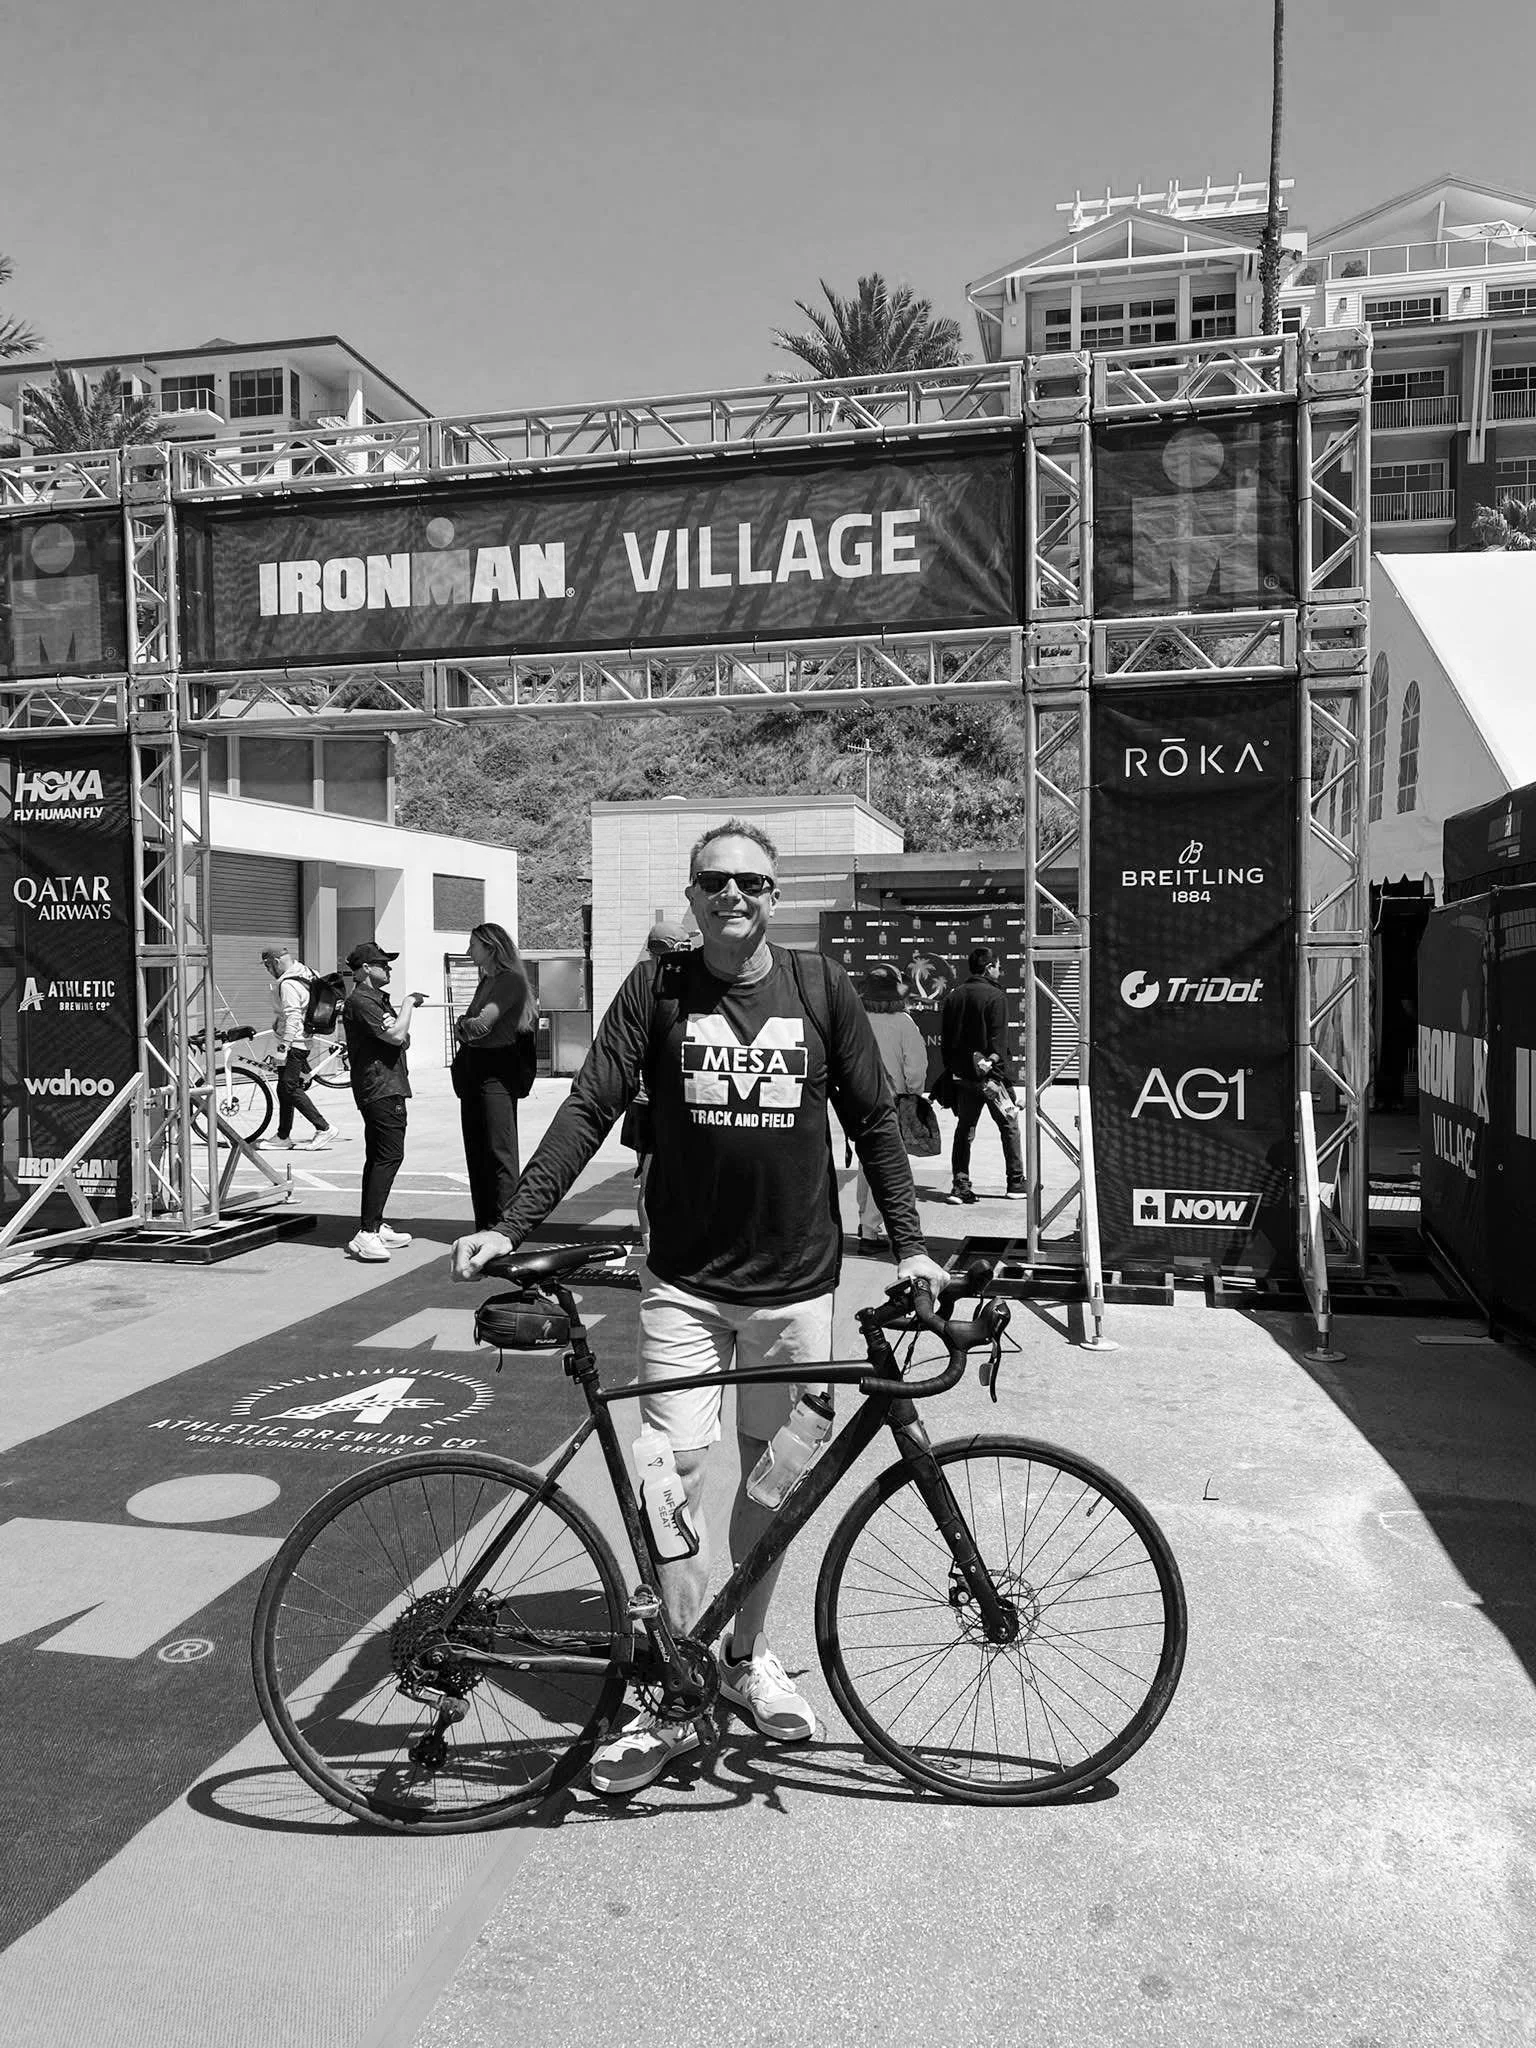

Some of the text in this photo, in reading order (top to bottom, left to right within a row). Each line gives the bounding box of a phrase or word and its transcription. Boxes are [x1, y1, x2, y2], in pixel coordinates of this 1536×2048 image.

[259, 508, 920, 617] IRONMAN VILLAGE
[14, 769, 104, 803] HOKA
[14, 806, 104, 821] FLY HUMAN FLY
[1122, 867, 1264, 887] BREITLING
[13, 875, 112, 909] QATAR
[1172, 890, 1211, 903] 1884
[38, 903, 112, 921] AIRWAYS
[48, 980, 115, 998] ATHLETIC
[1167, 977, 1264, 1003] TriDot
[59, 1001, 94, 1011] BREWING
[702, 1046, 789, 1074] MESA
[24, 1069, 115, 1096] wahoo
[1131, 1067, 1245, 1121] AG1
[690, 1109, 795, 1129] TRACK AND FIELD
[18, 1157, 118, 1179] IROAN
[1171, 1198, 1248, 1221] NOW
[147, 1418, 288, 1436] ATHLETIC
[291, 1427, 434, 1447] BREWING
[185, 1434, 404, 1456] NON-ALCOHOLIC BREWS
[658, 1505, 671, 1529] SEAT
